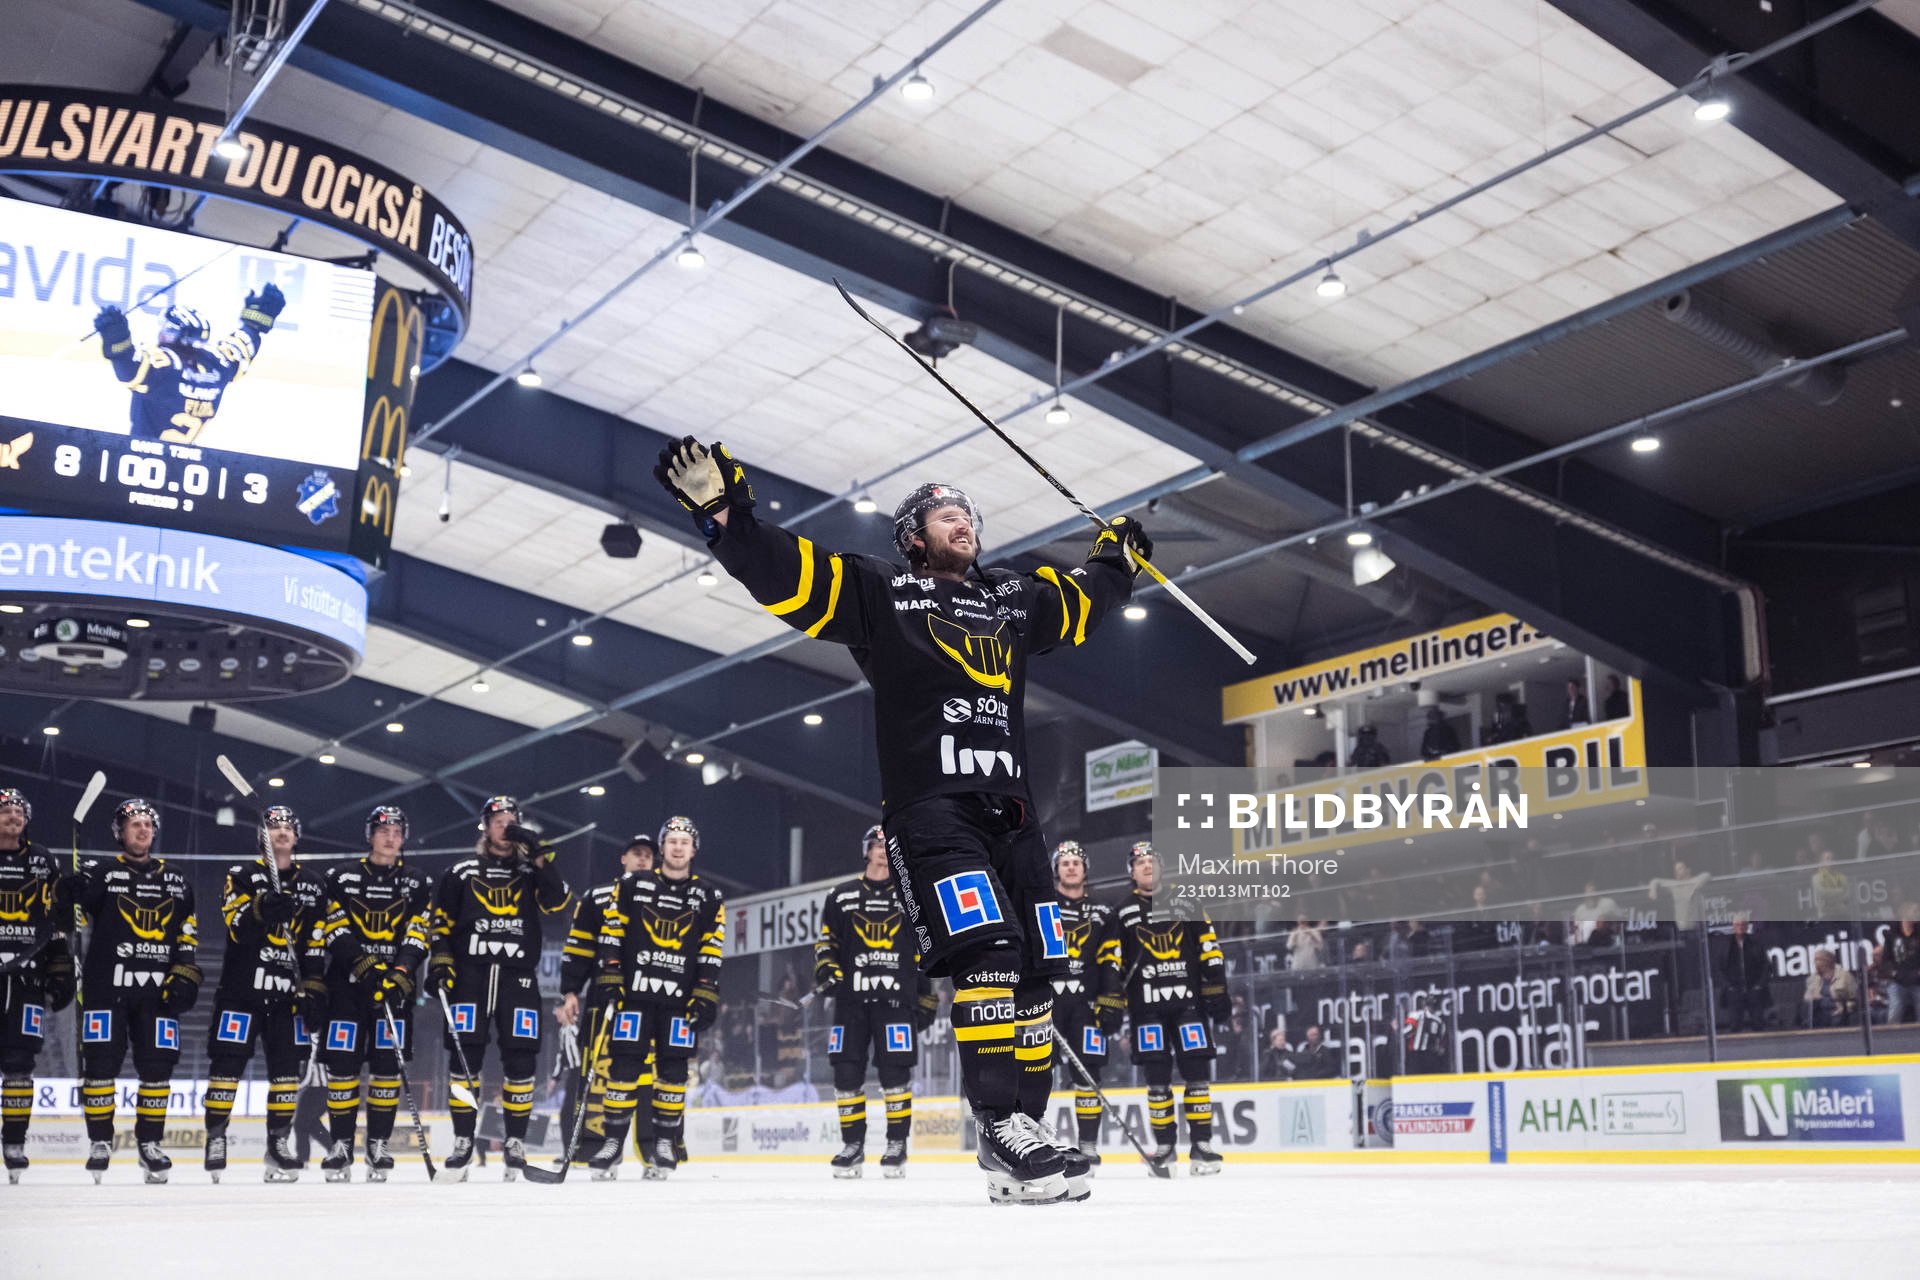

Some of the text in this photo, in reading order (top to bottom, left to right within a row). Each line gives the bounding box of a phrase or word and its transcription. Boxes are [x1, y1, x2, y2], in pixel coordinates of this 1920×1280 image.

[226, 133, 299, 198] DU
[302, 155, 424, 252] OCKSÅ
[55, 445, 269, 504] 8 00.0 3
[0, 536, 221, 594] enteknik
[283, 575, 299, 604] Vi
[1274, 621, 1546, 705] www.mellinger.
[1543, 735, 1641, 800] BIL
[136, 942, 170, 954] SÖRBY
[760, 899, 824, 948] Hisst
[652, 951, 686, 965] SÖRBY
[1157, 961, 1187, 972] SÖRBY
[1318, 991, 1389, 1025] notar
[1477, 976, 1561, 1013] notar
[1569, 966, 1659, 1005] notar
[1455, 1014, 1600, 1074] notar
[1519, 1098, 1599, 1133] AHA!
[1741, 1083, 1875, 1137] N Måleri
